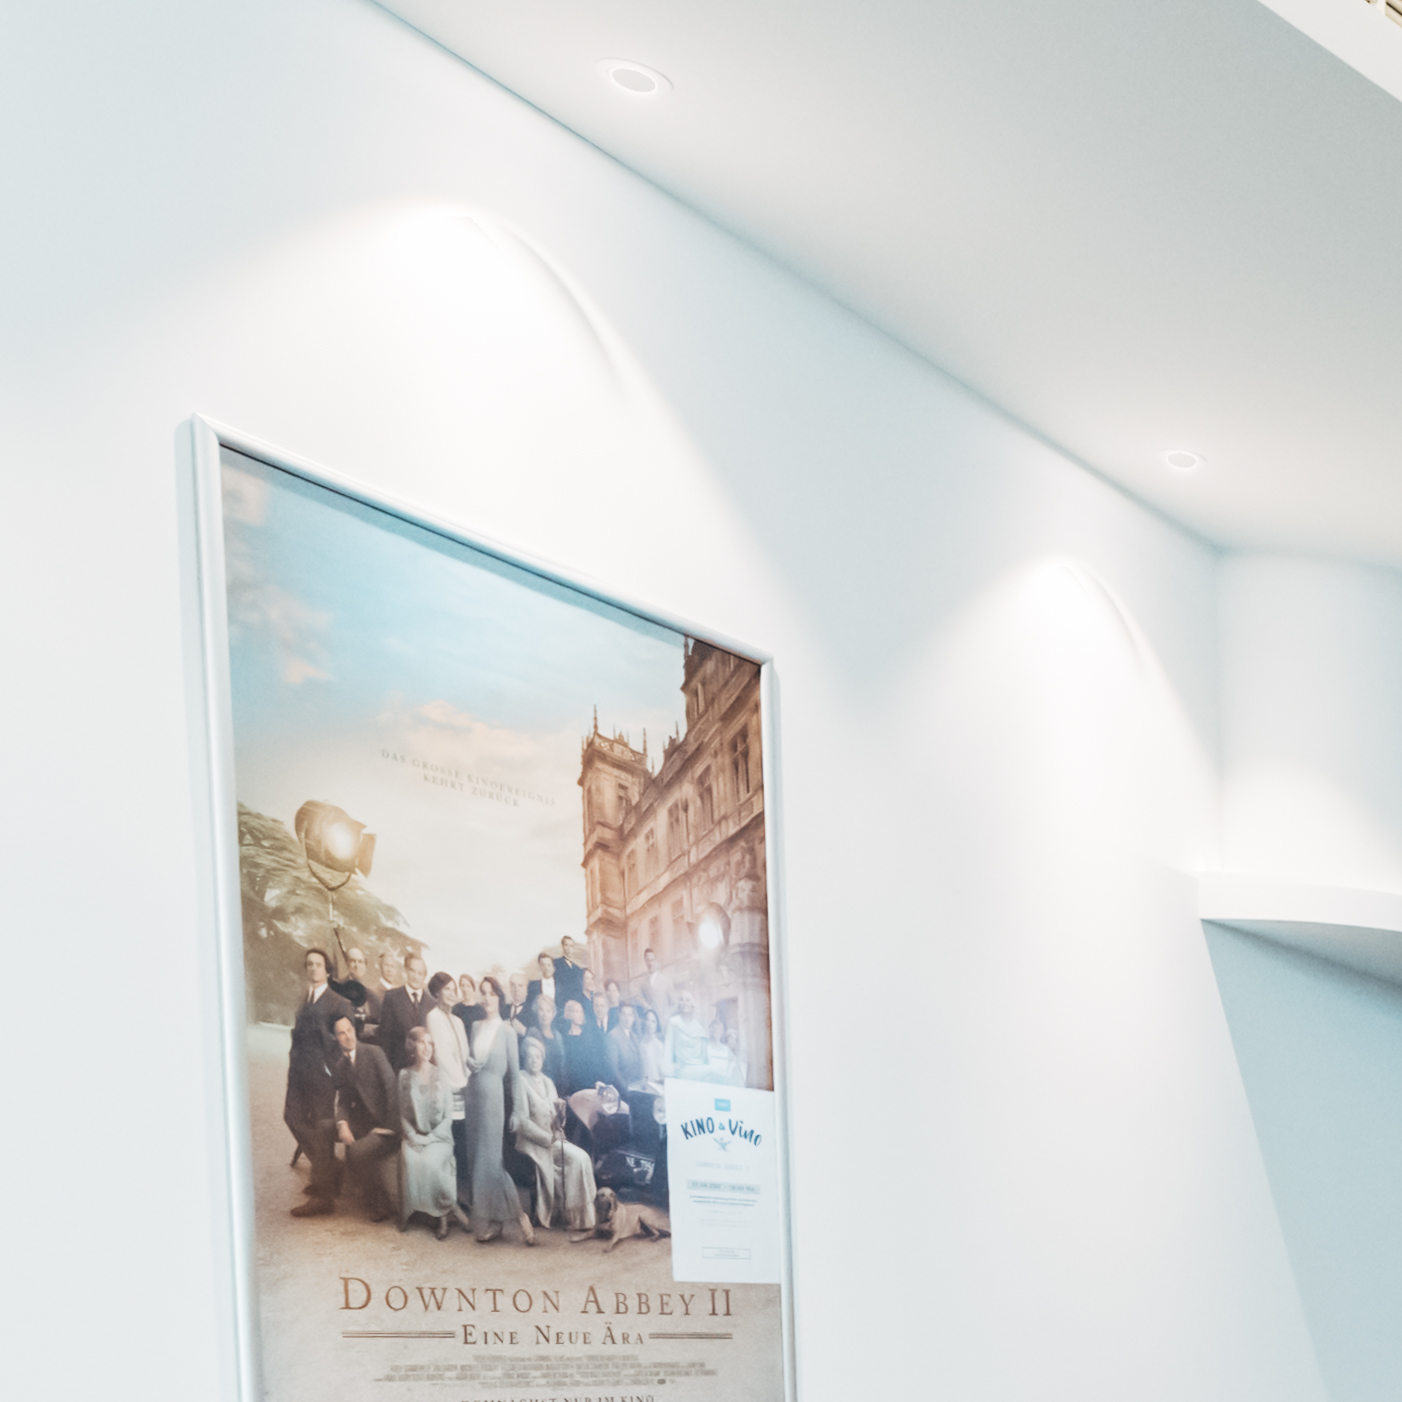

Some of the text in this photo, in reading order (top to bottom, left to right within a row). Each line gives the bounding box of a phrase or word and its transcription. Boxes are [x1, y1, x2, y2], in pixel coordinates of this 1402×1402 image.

[681, 1117, 762, 1146] KINO & Vino
[339, 1276, 733, 1317] DOWNTON ABBEY II
